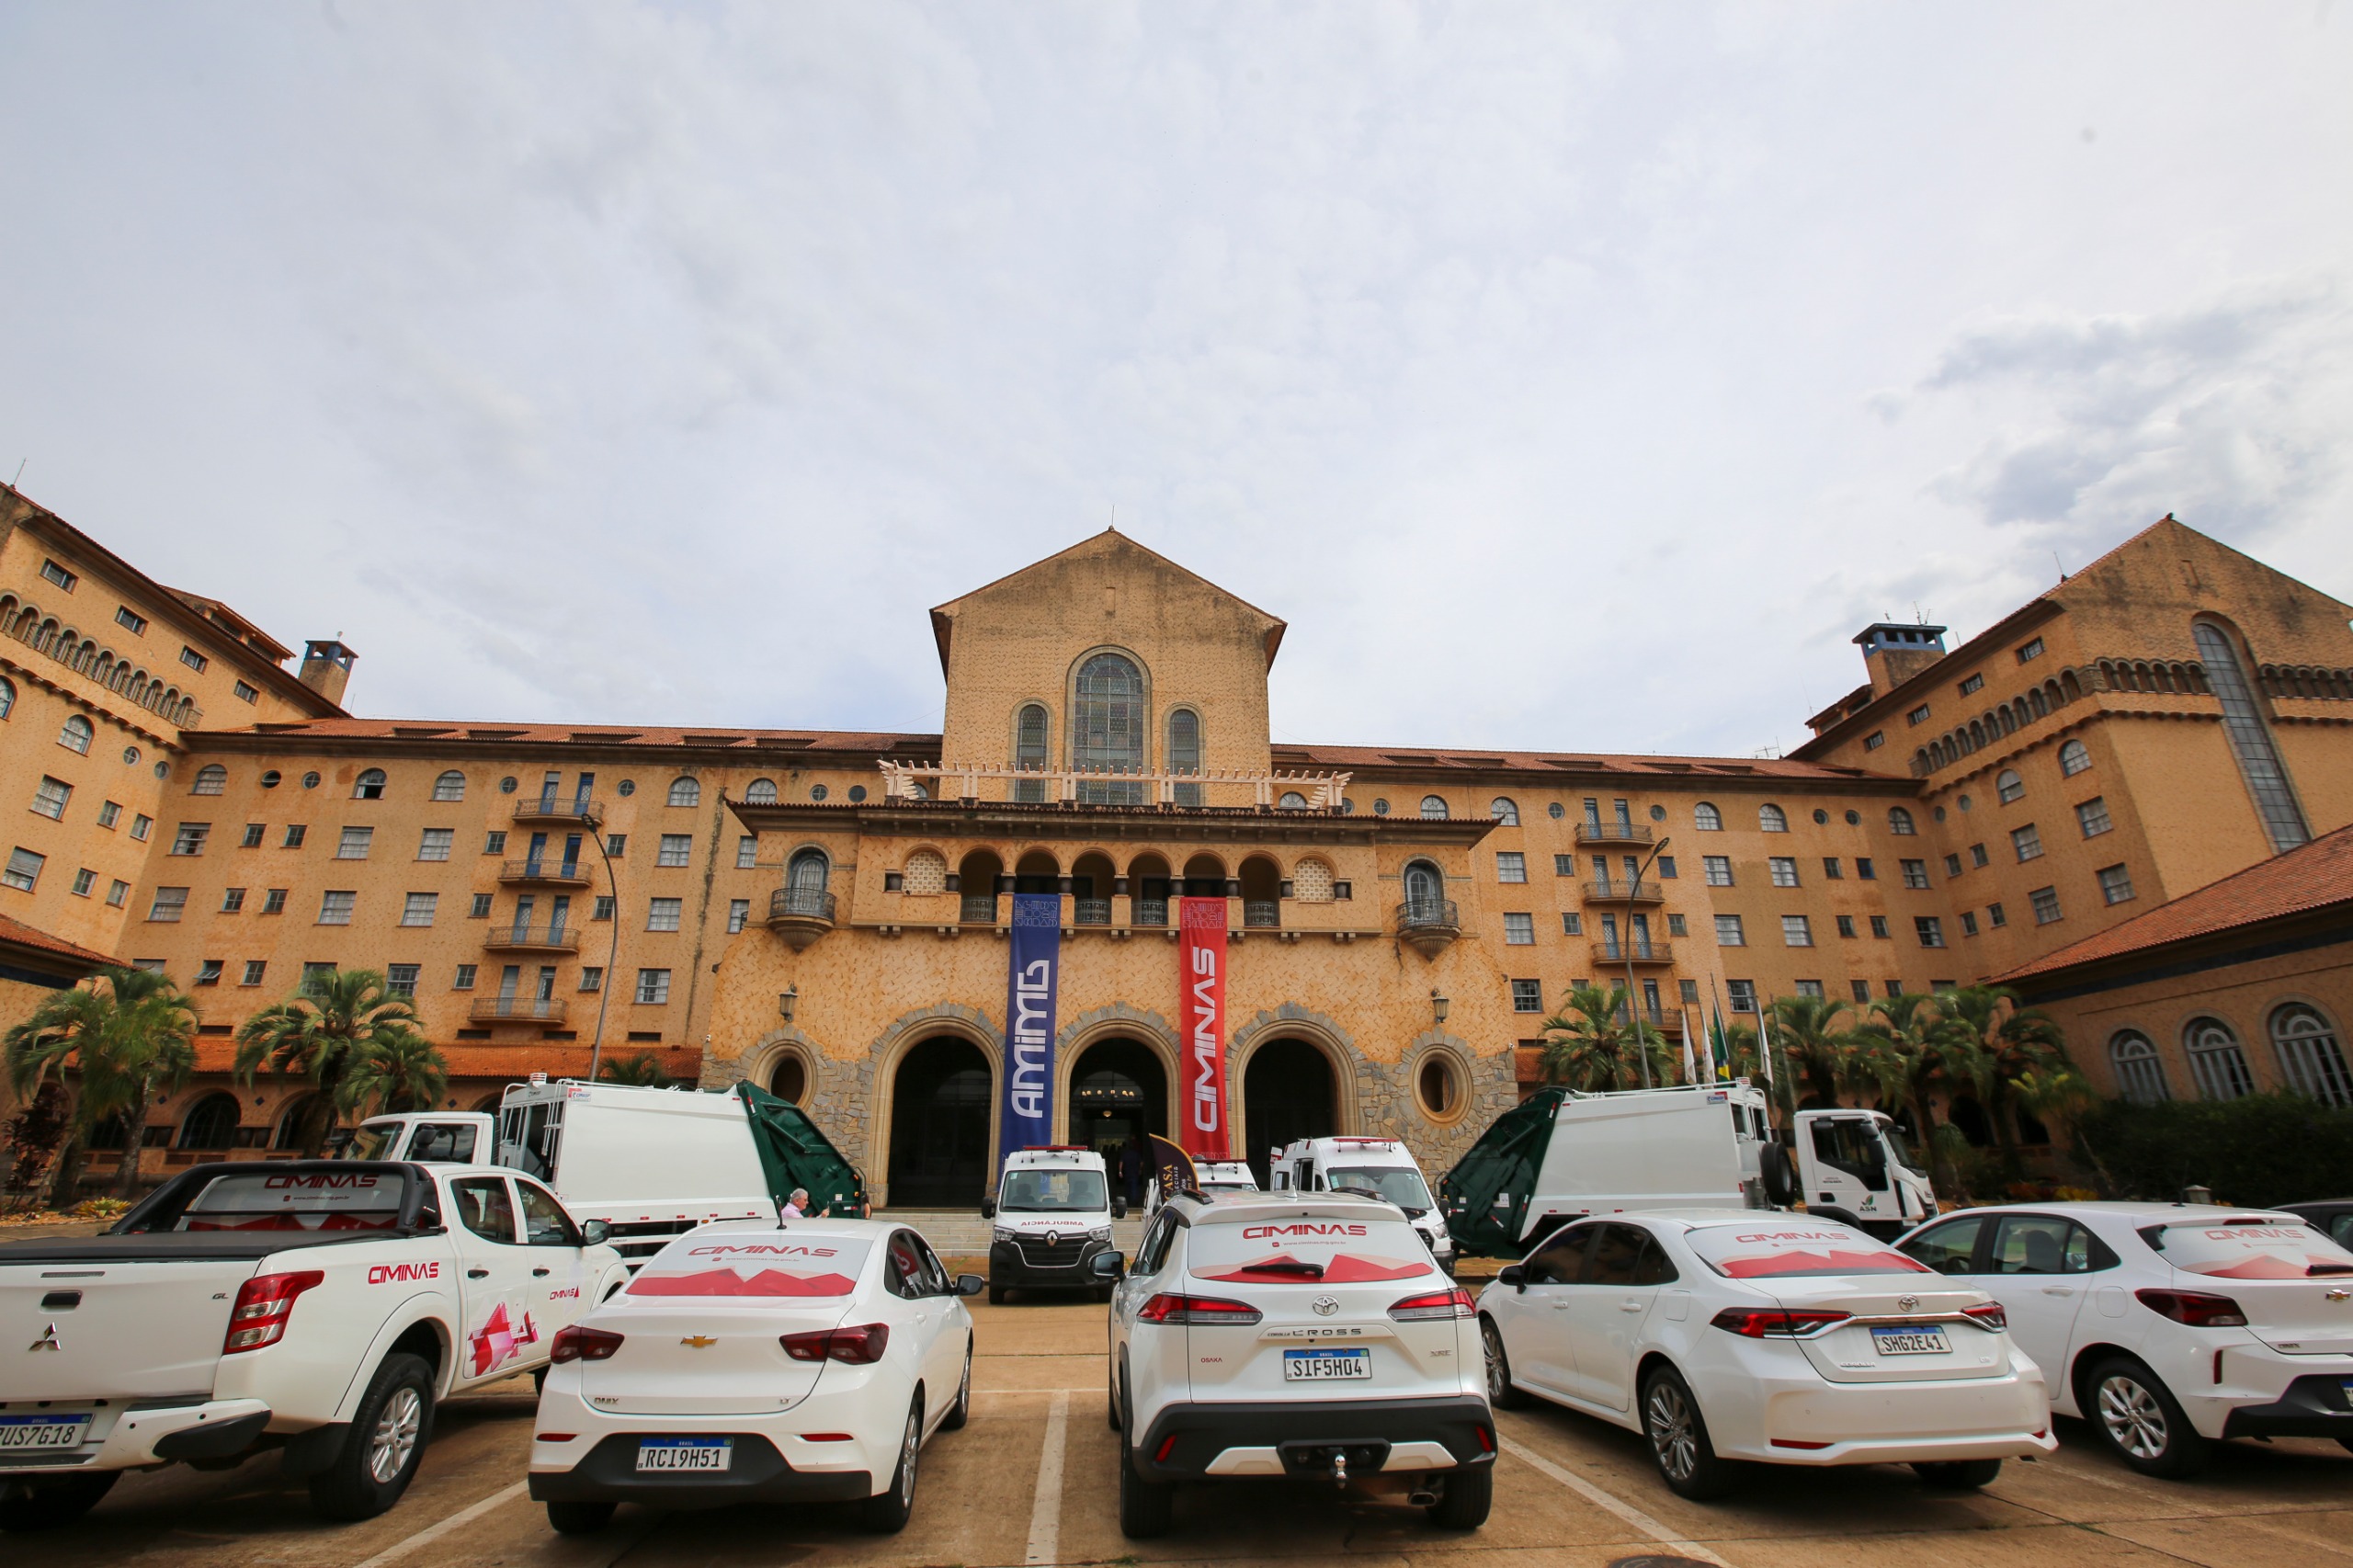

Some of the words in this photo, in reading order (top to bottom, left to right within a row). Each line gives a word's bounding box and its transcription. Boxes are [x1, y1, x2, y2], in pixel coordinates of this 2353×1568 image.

[1192, 946, 1218, 1132] CIMINAS
[264, 1174, 380, 1188] CIMINAS
[1163, 1164, 1174, 1201] CASA
[1243, 1223, 1367, 1239] CIMINAS
[1735, 1233, 1850, 1243] CIMINAS
[2204, 1228, 2306, 1240] CIMINAS
[688, 1245, 839, 1257] CIMINAS
[368, 1262, 439, 1285] CIMINAS
[549, 1288, 574, 1301] CIMINAS
[1292, 1328, 1362, 1336] CROSS
[1881, 1334, 1944, 1352] SHG2E41
[1293, 1358, 1363, 1377] SIF5H04
[644, 1449, 721, 1468] RCI9H51
